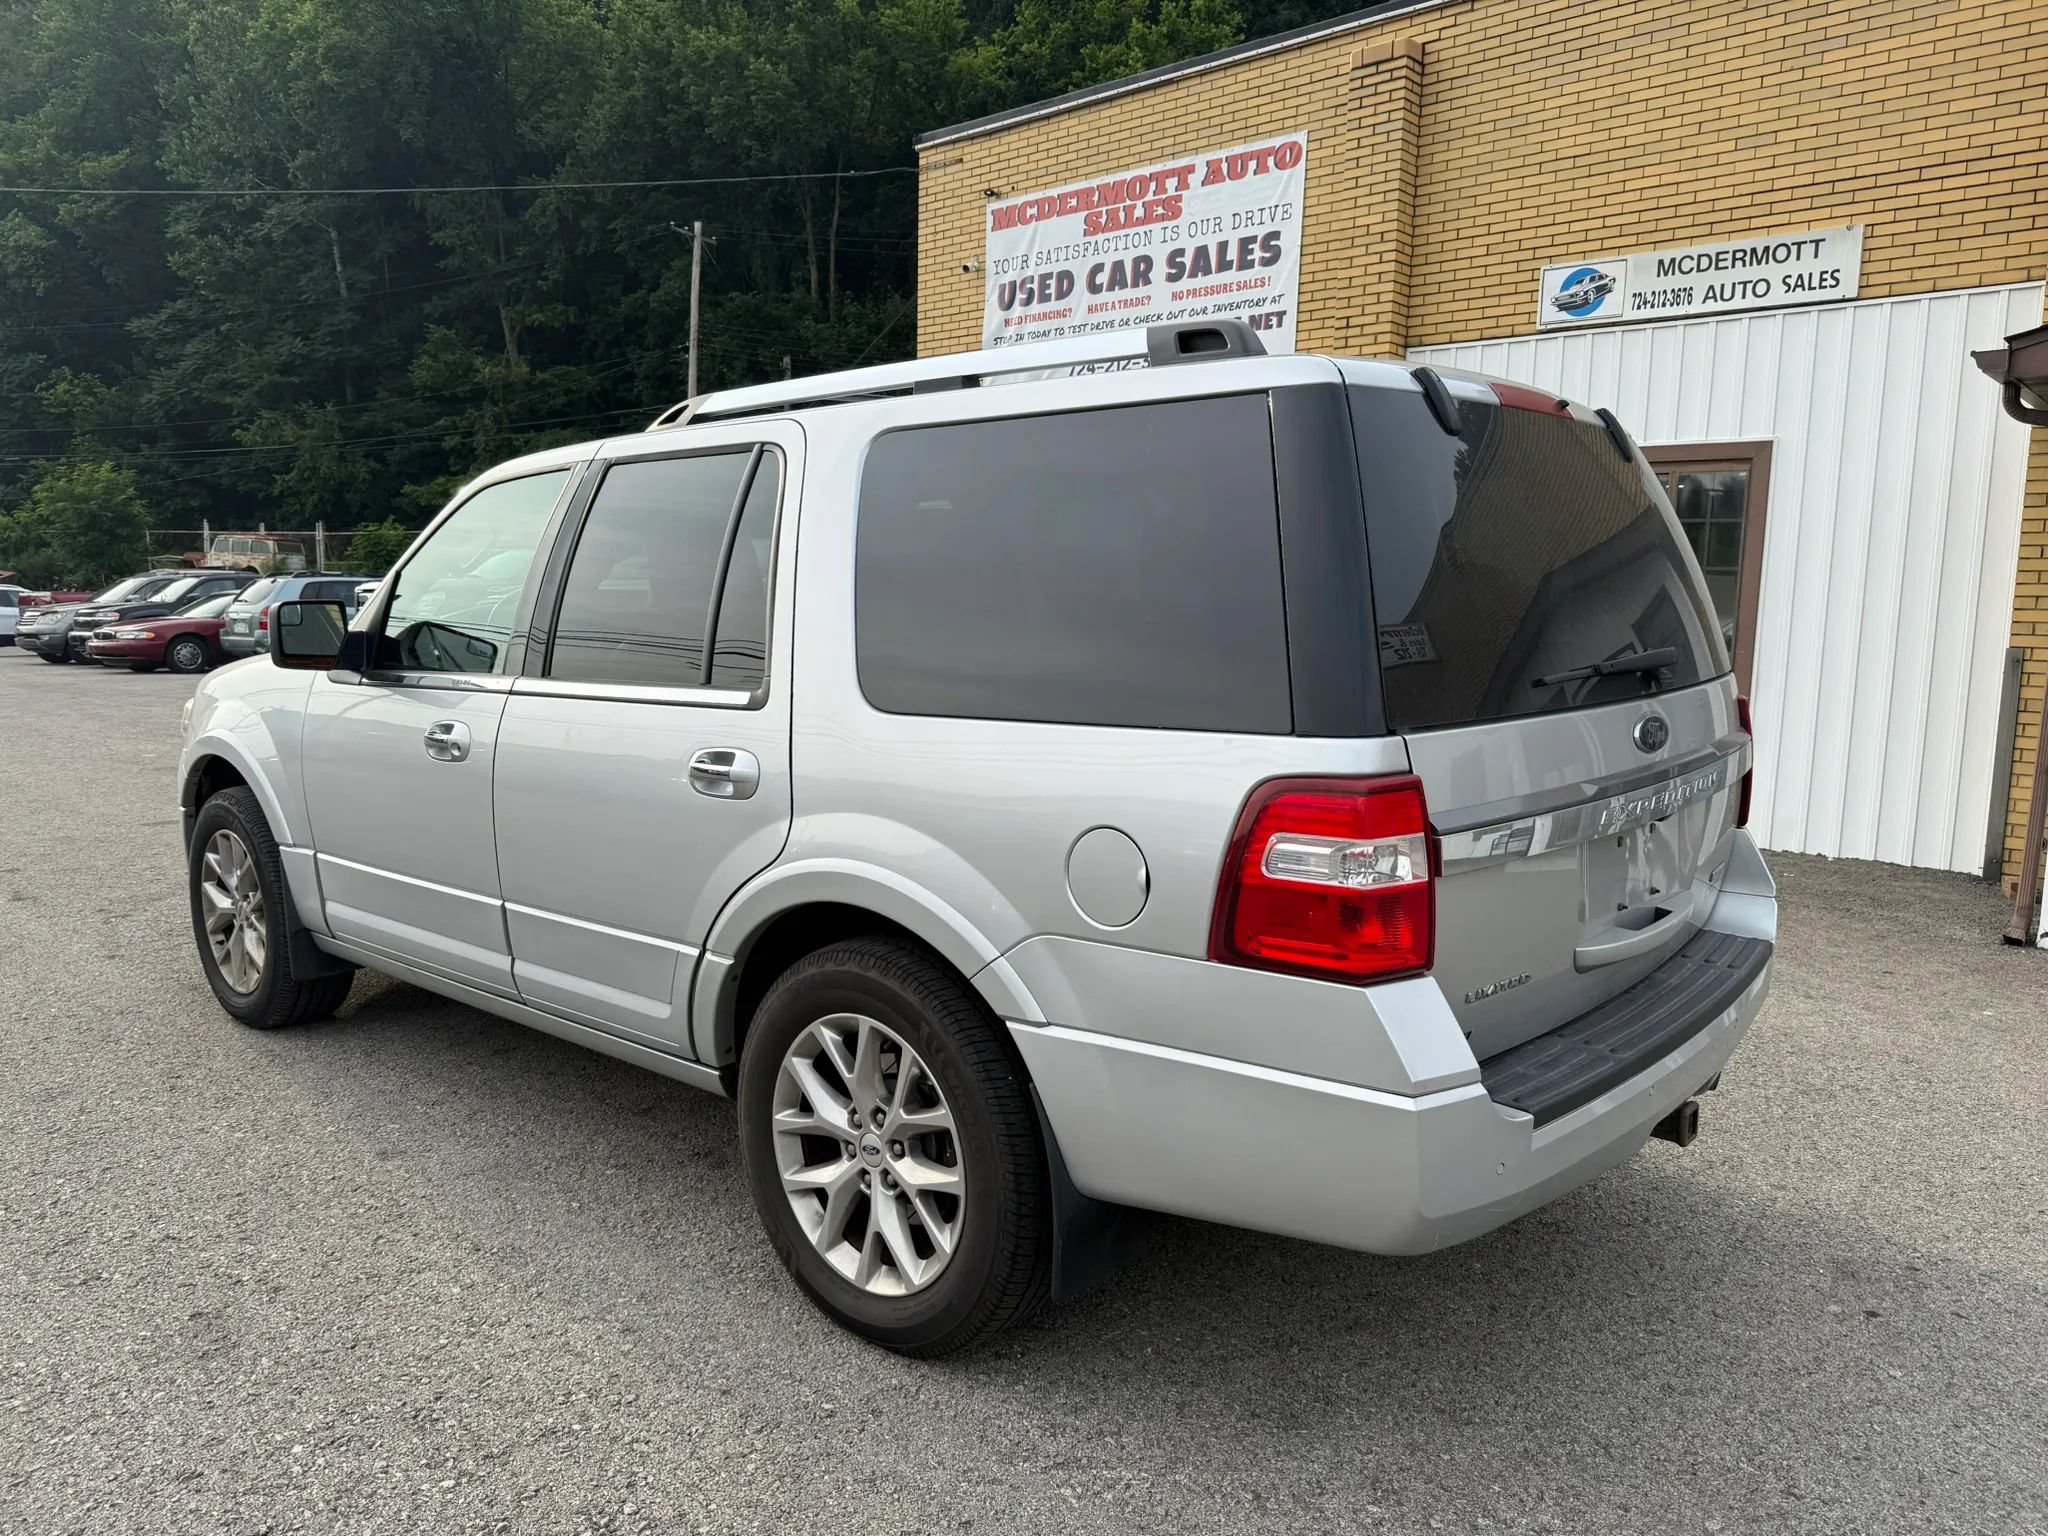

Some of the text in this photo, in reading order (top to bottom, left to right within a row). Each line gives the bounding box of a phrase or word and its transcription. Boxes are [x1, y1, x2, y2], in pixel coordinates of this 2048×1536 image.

[991, 140, 1303, 232] MCDERMOTT AUTO
[1083, 193, 1183, 238] SALES
[993, 202, 1293, 276] YOUR SATISFACTION IS OUR DRIVE
[1656, 237, 1826, 278] MCDERMOTT
[997, 230, 1282, 312] USED CAR SALES
[1171, 288, 1185, 302] NO
[1186, 281, 1234, 300] PRESSURE
[1702, 268, 1841, 304] AUTO SALES
[1004, 307, 1073, 329] NEED FINANCING?
[1014, 333, 1025, 343] IN
[1027, 328, 1053, 341] TODAY
[1054, 327, 1065, 337] TO
[1067, 323, 1090, 334] TEST
[1090, 319, 1116, 331] DRIVE
[1118, 317, 1131, 326] OR
[1133, 313, 1164, 325] CHECK
[1166, 309, 1188, 321] OUT
[1188, 305, 1209, 317] OUR
[1210, 296, 1268, 315] INVENTORY
[1269, 293, 1285, 305] AT
[1087, 295, 1152, 315] HAVE A TRADE?
[1631, 286, 1693, 311] 724-212-3676
